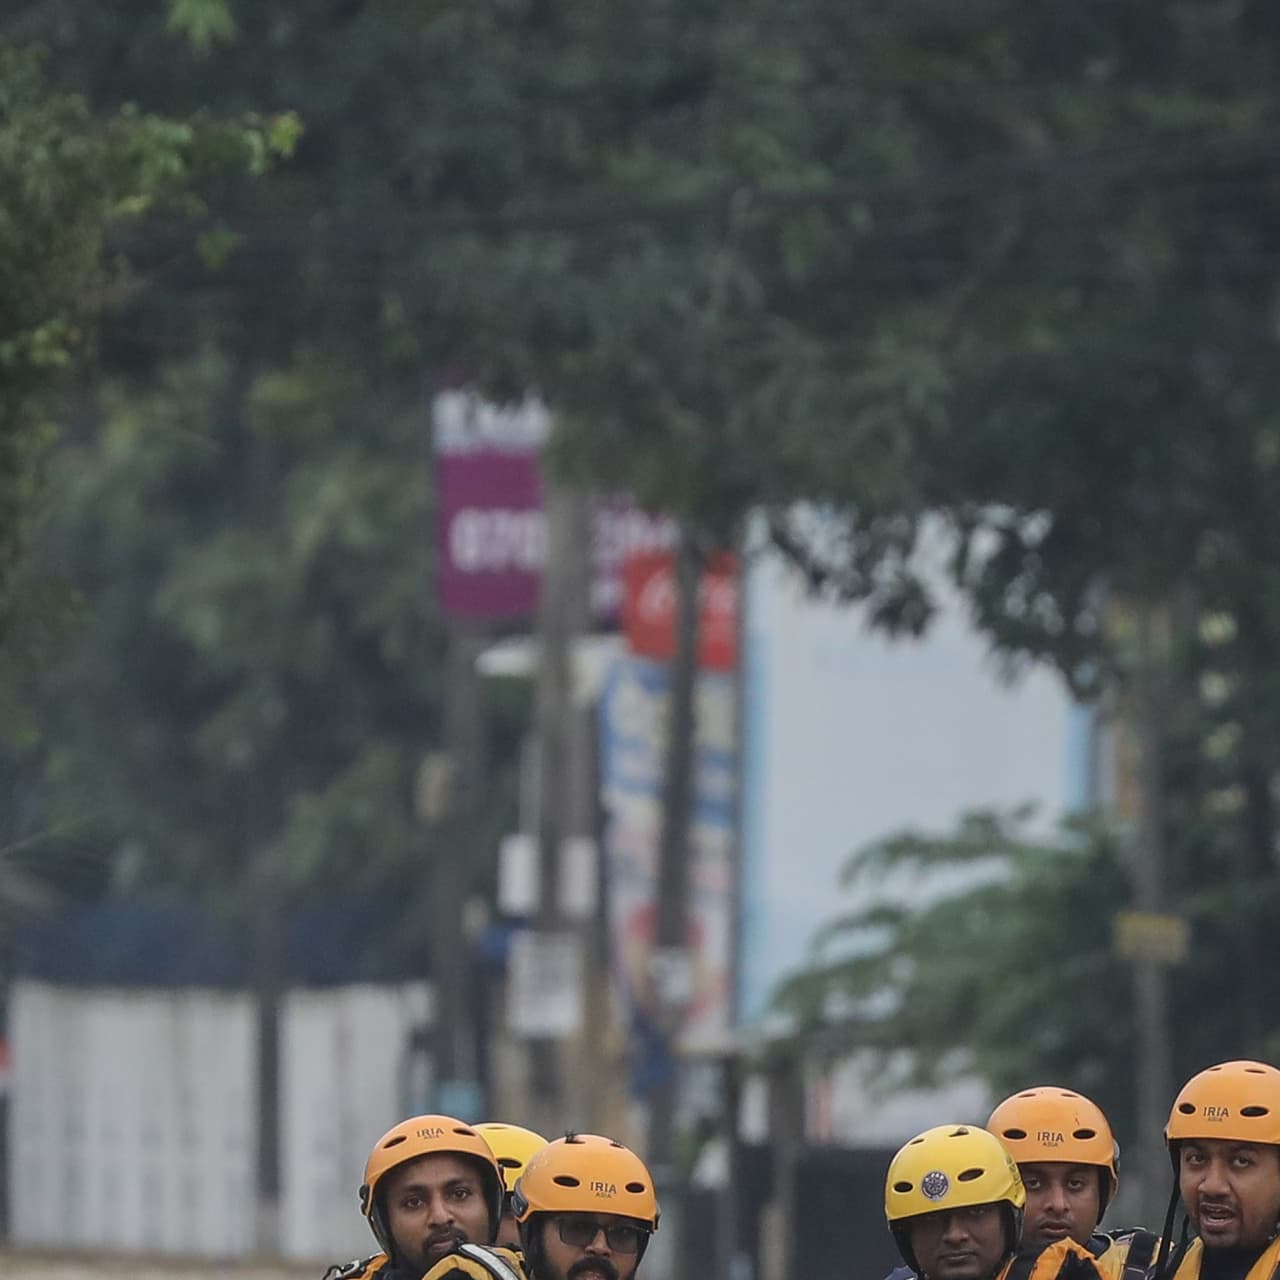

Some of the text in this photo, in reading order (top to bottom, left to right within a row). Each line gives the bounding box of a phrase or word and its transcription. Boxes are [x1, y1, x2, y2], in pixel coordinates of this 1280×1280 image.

[1203, 1106, 1229, 1117] IRIA
[416, 1128, 444, 1138] IRIA
[1037, 1131, 1064, 1143] IRIA
[590, 1181, 617, 1194] IRIA
